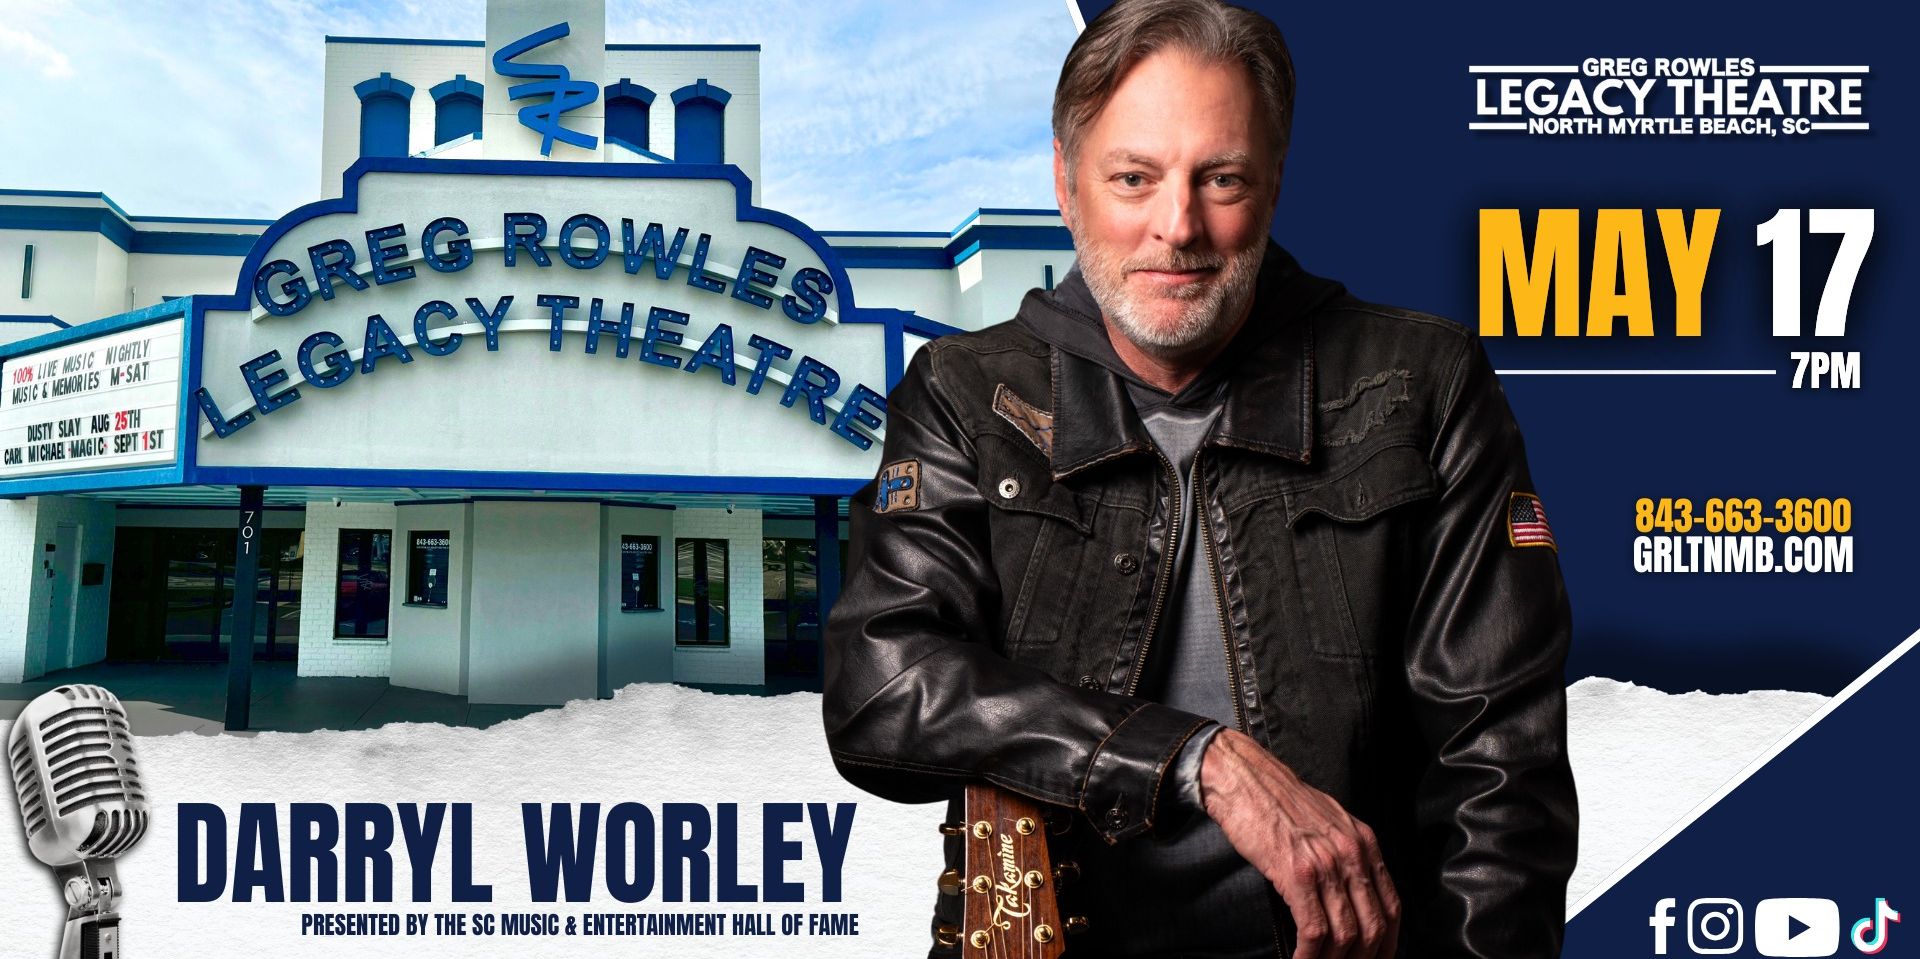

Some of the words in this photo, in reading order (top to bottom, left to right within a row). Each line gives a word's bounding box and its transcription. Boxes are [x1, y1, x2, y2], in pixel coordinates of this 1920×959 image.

[254, 216, 474, 317] GREG
[503, 212, 834, 325] ROWLES
[12, 365, 34, 385] 100%
[37, 360, 58, 380] LIVE
[62, 351, 95, 374] MUSIC
[105, 339, 150, 366] NIGHTLY
[12, 384, 38, 405] MUSIC
[42, 381, 47, 399] &
[52, 371, 100, 397] MEMORIES
[110, 361, 149, 386] M-SAT
[194, 295, 515, 439] LEGACY
[536, 294, 888, 451] THEATRE
[4, 447, 23, 465] CARL
[28, 441, 65, 463] MICHAEL
[114, 432, 139, 453] SEPT
[142, 429, 164, 451] 1ST
[27, 422, 53, 443] DUSTY
[58, 418, 81, 438] SLAY
[91, 413, 110, 434] AUG
[115, 409, 141, 431] 25TH
[242, 511, 254, 555] 701
[416, 538, 451, 546] 843-663-360
[993, 833, 1032, 930] Takamine
